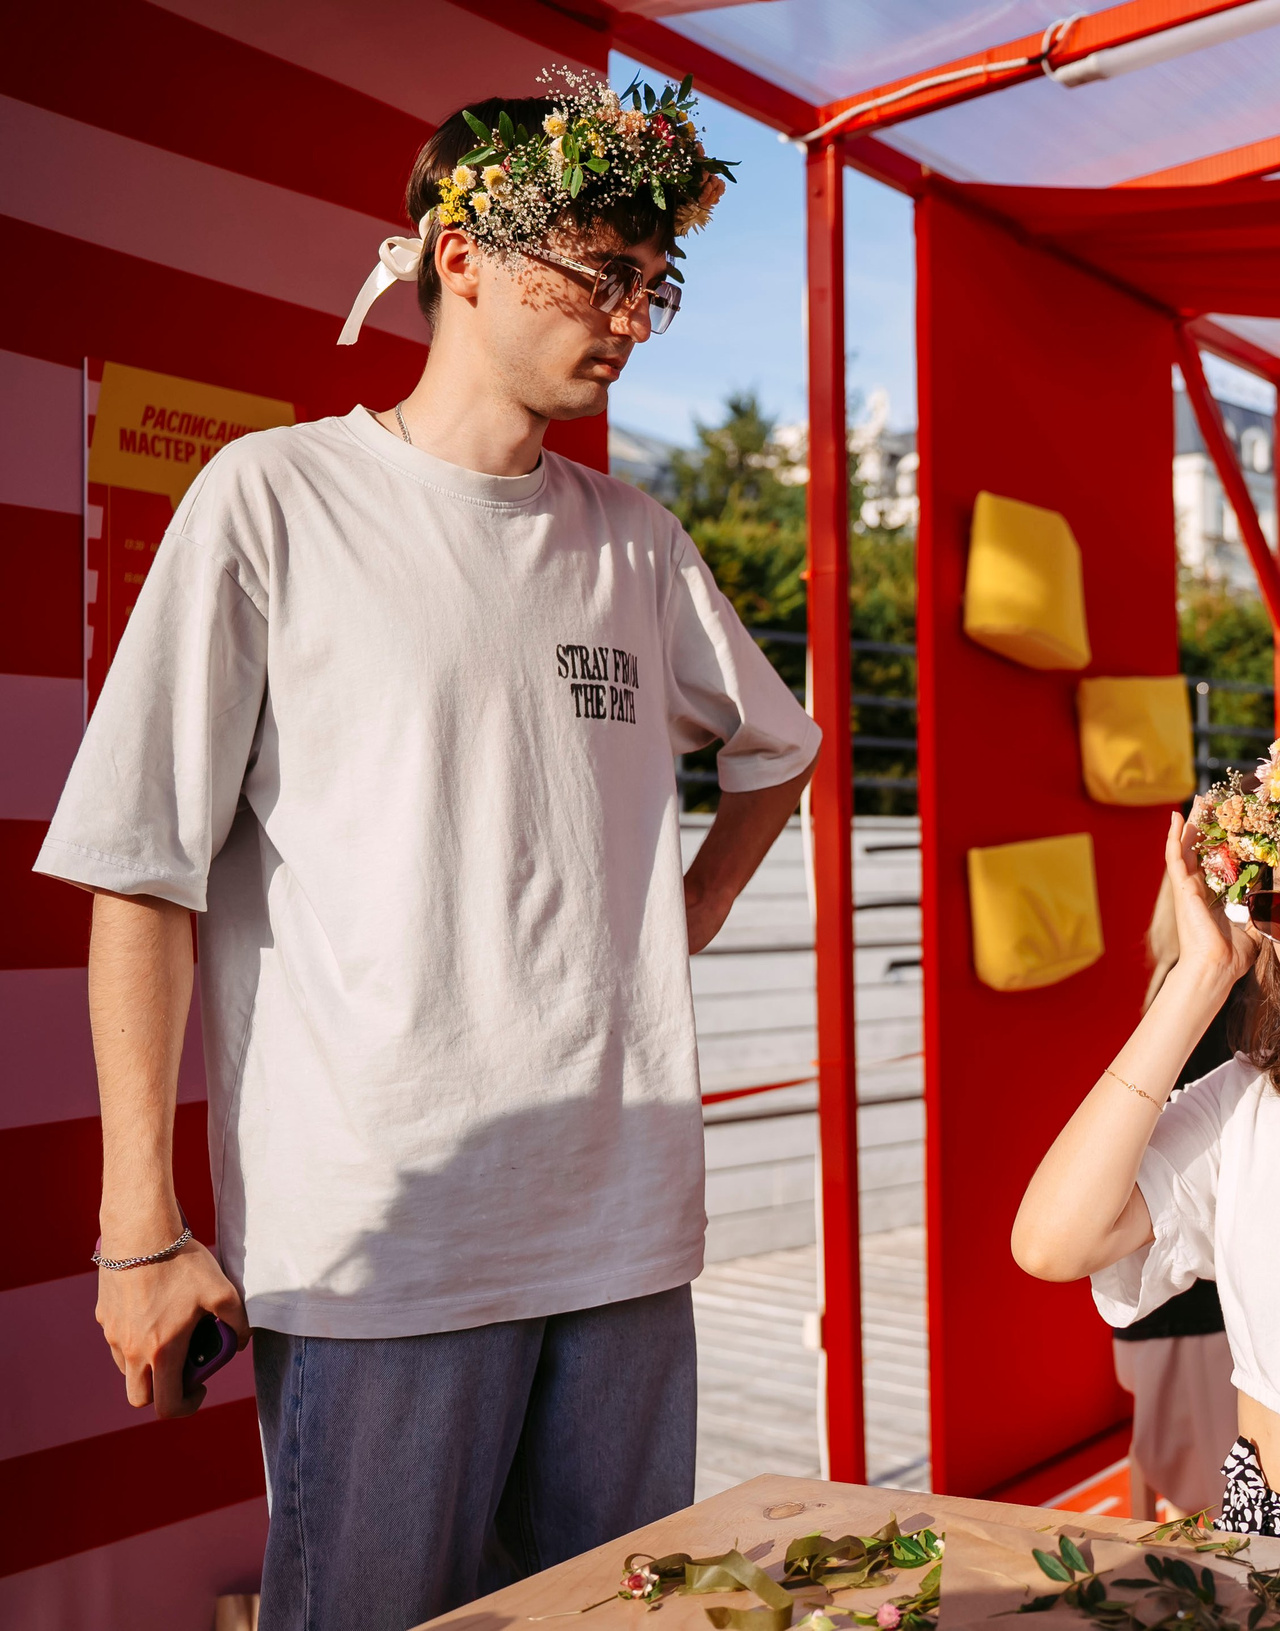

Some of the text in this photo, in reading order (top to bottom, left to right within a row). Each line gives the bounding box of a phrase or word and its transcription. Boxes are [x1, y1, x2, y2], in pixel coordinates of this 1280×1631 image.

[141, 405, 262, 442] РАСПИСАН
[119, 427, 196, 464] МАСТЕР
[556, 644, 639, 689] STRAY FROM
[570, 683, 636, 725] THE PATH
